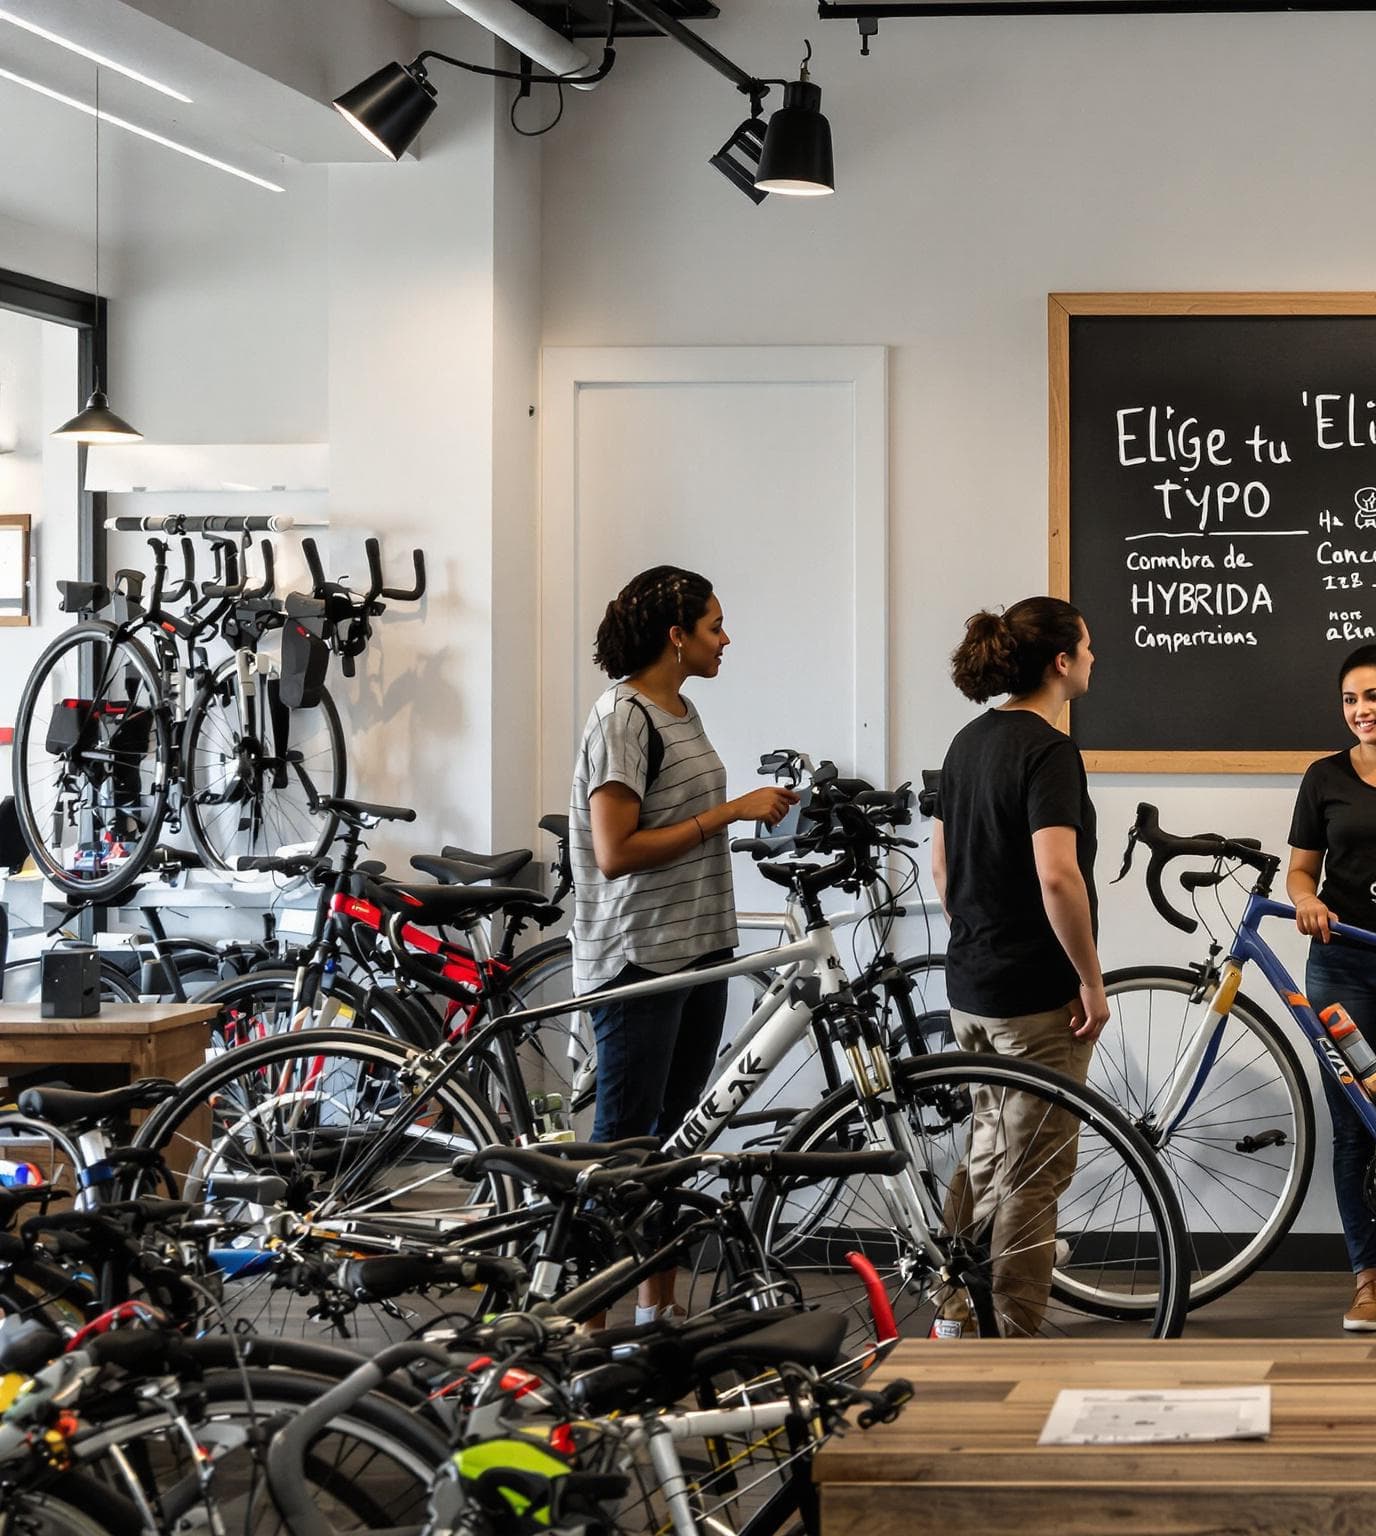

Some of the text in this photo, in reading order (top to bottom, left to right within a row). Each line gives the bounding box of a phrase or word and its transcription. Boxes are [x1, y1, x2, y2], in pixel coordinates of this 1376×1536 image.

[1245, 424, 1292, 464] tu
[1223, 543, 1254, 569] de
[1130, 580, 1273, 616] HYBRIDA
